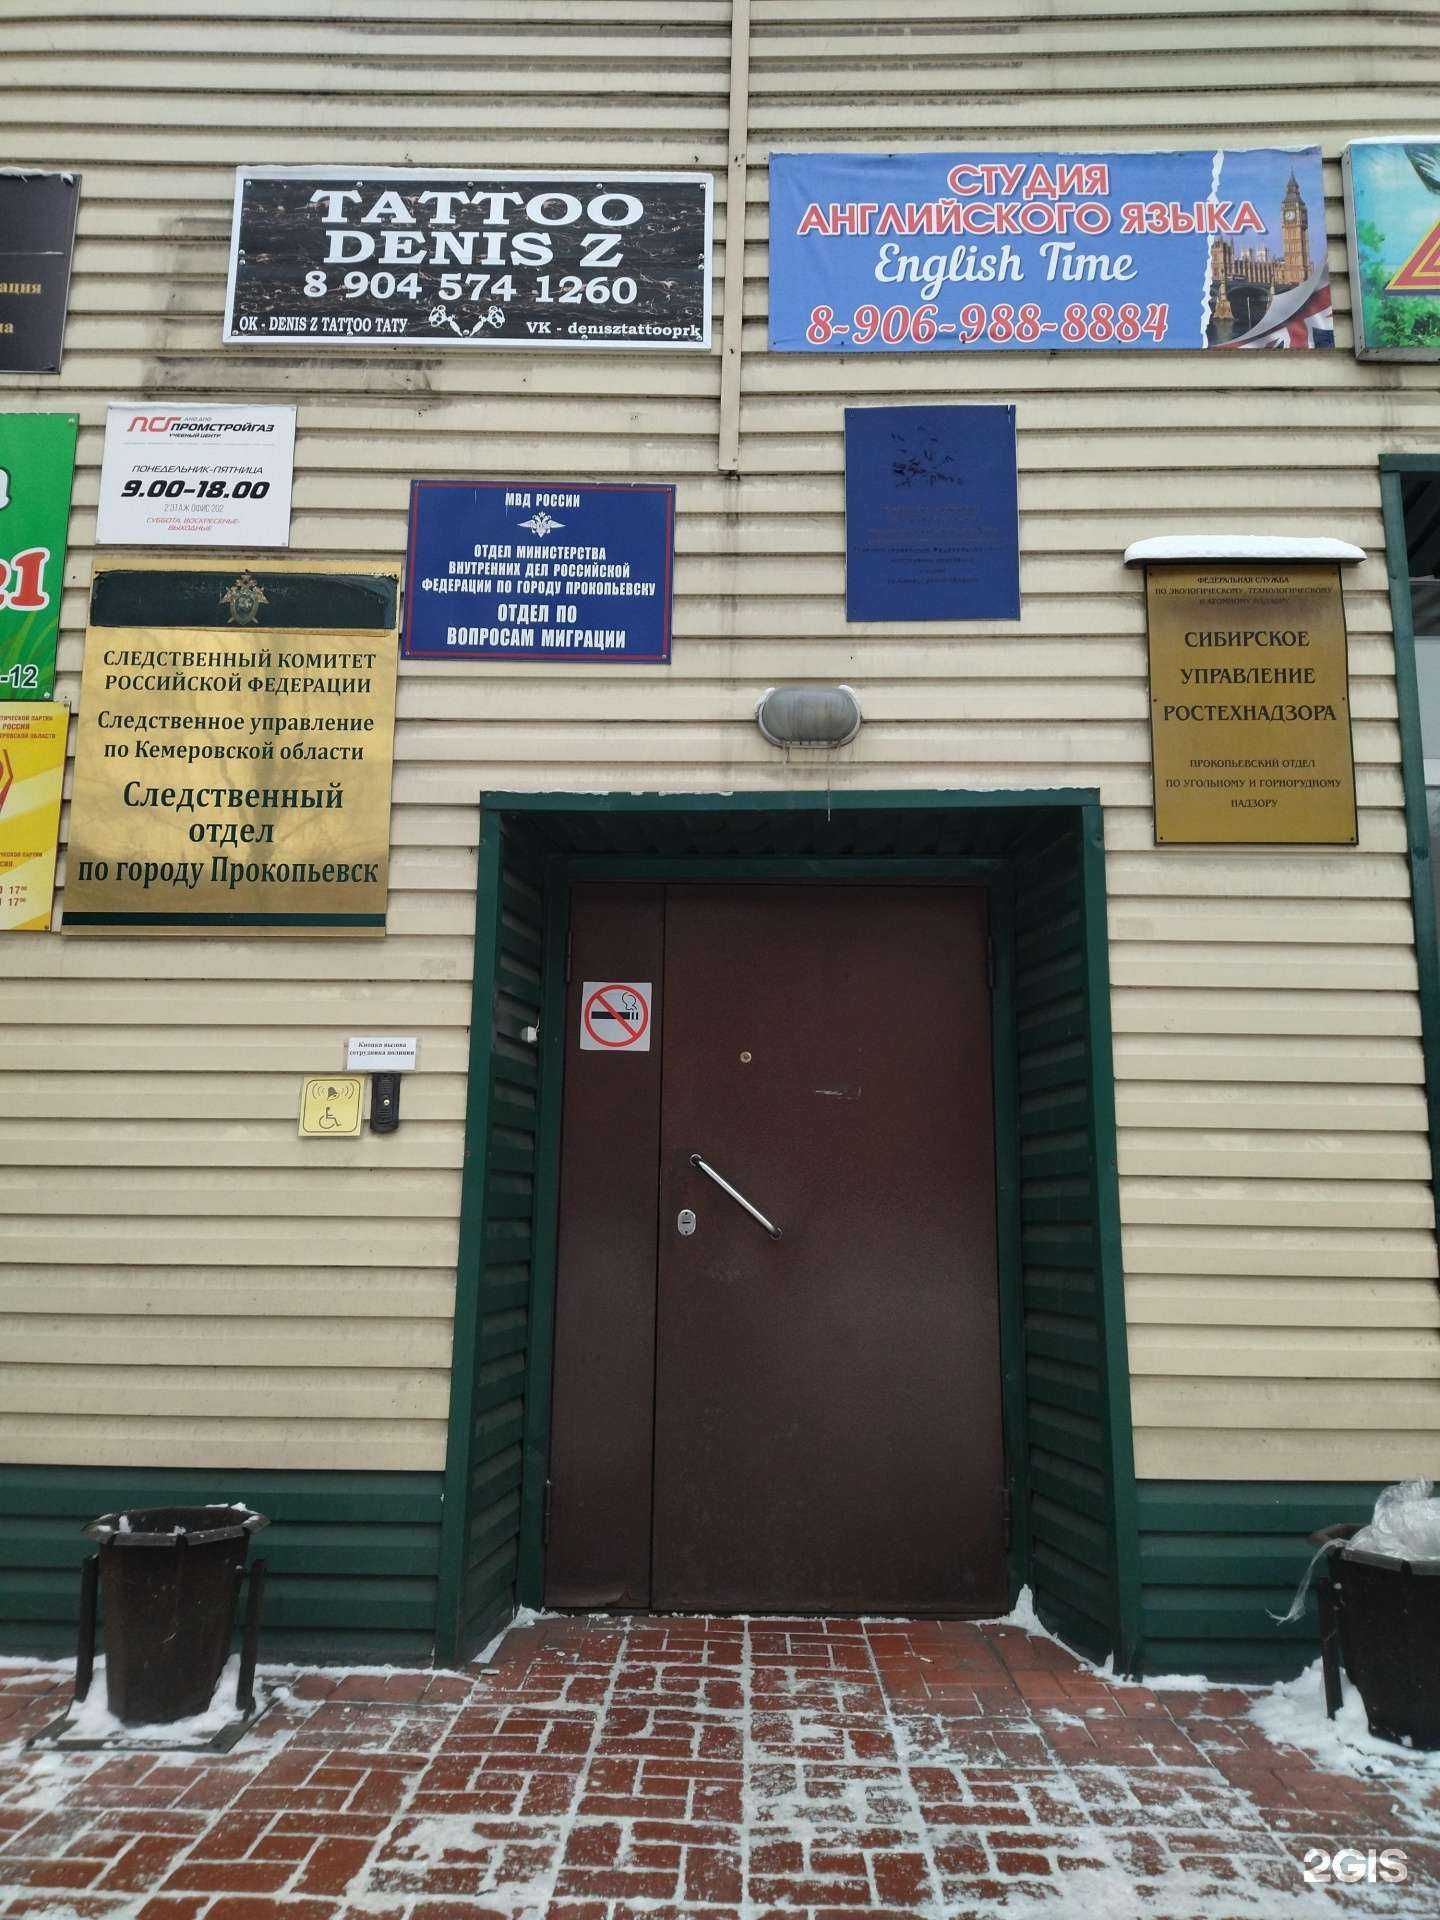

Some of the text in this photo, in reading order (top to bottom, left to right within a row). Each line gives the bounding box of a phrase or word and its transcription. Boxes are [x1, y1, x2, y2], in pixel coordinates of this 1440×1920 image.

[948, 163, 1109, 200] СТУДИЯ
[310, 189, 644, 227] TATTOO
[798, 199, 1267, 235] АНГЛИЙСКОГО ЯЗЫКА
[323, 230, 623, 269] DENIS Z
[875, 241, 1138, 301] English Time
[303, 270, 638, 304] 8 904 574 1260
[269, 316, 307, 331] DENIS
[310, 317, 318, 331] Z
[321, 317, 371, 332] TATTOO
[375, 318, 408, 333] TATY
[526, 321, 551, 334] VK
[806, 302, 1169, 344] 8-906-988-8884
[171, 423, 275, 432] ПРОМСТРОЙГАЗ
[132, 465, 263, 474] ПОНЕДЕЛЬНИК-ПЯТНИЦА
[121, 480, 270, 499] 9.00-18.00
[505, 493, 580, 508] МВД РОССИИ
[474, 545, 606, 560] ОТДЕЛ МИНИСТЕРСТВА
[449, 561, 630, 578] ВНУТРЕННИХ ДЕЛ РОССИЙСКОЙ
[422, 578, 656, 596] ФЕДЕРАЦИИ ПО ГОРОДУ ПРОКОПЬЕВСКУ
[1197, 576, 1253, 584] ФЕДЕРАЛЬНАЯ
[497, 604, 577, 624] ОТДЕЛ ПО
[447, 627, 625, 650] ВОПРОСАМ МИГРАЦИИ
[1185, 631, 1309, 647] СИБИРСКОЕ
[103, 649, 376, 670] СЛЕДСТВЕННЫЙ КОМИТЕТ
[105, 673, 371, 695] РОССИЙСКОЙ ФЕДЕРАЦИИ
[1180, 668, 1315, 684] УПРАВЛЕНИЕ
[98, 710, 374, 735] Следственное управление
[1163, 705, 1337, 722] РОСТЕХНАДЗОРА
[104, 741, 363, 763] по Кемеровской области
[1190, 759, 1315, 768] ПРОКОПЬЕВСКИЙ ОТДЕЛ
[1166, 779, 1342, 789] ПО УГОЛЬНОМУ И ГОРНОРУДНОМУ
[124, 781, 343, 812] Следственный
[1231, 799, 1278, 808] НАДЗОРУ
[189, 822, 274, 847] отдел
[79, 856, 378, 888] по городу Прокопьевск
